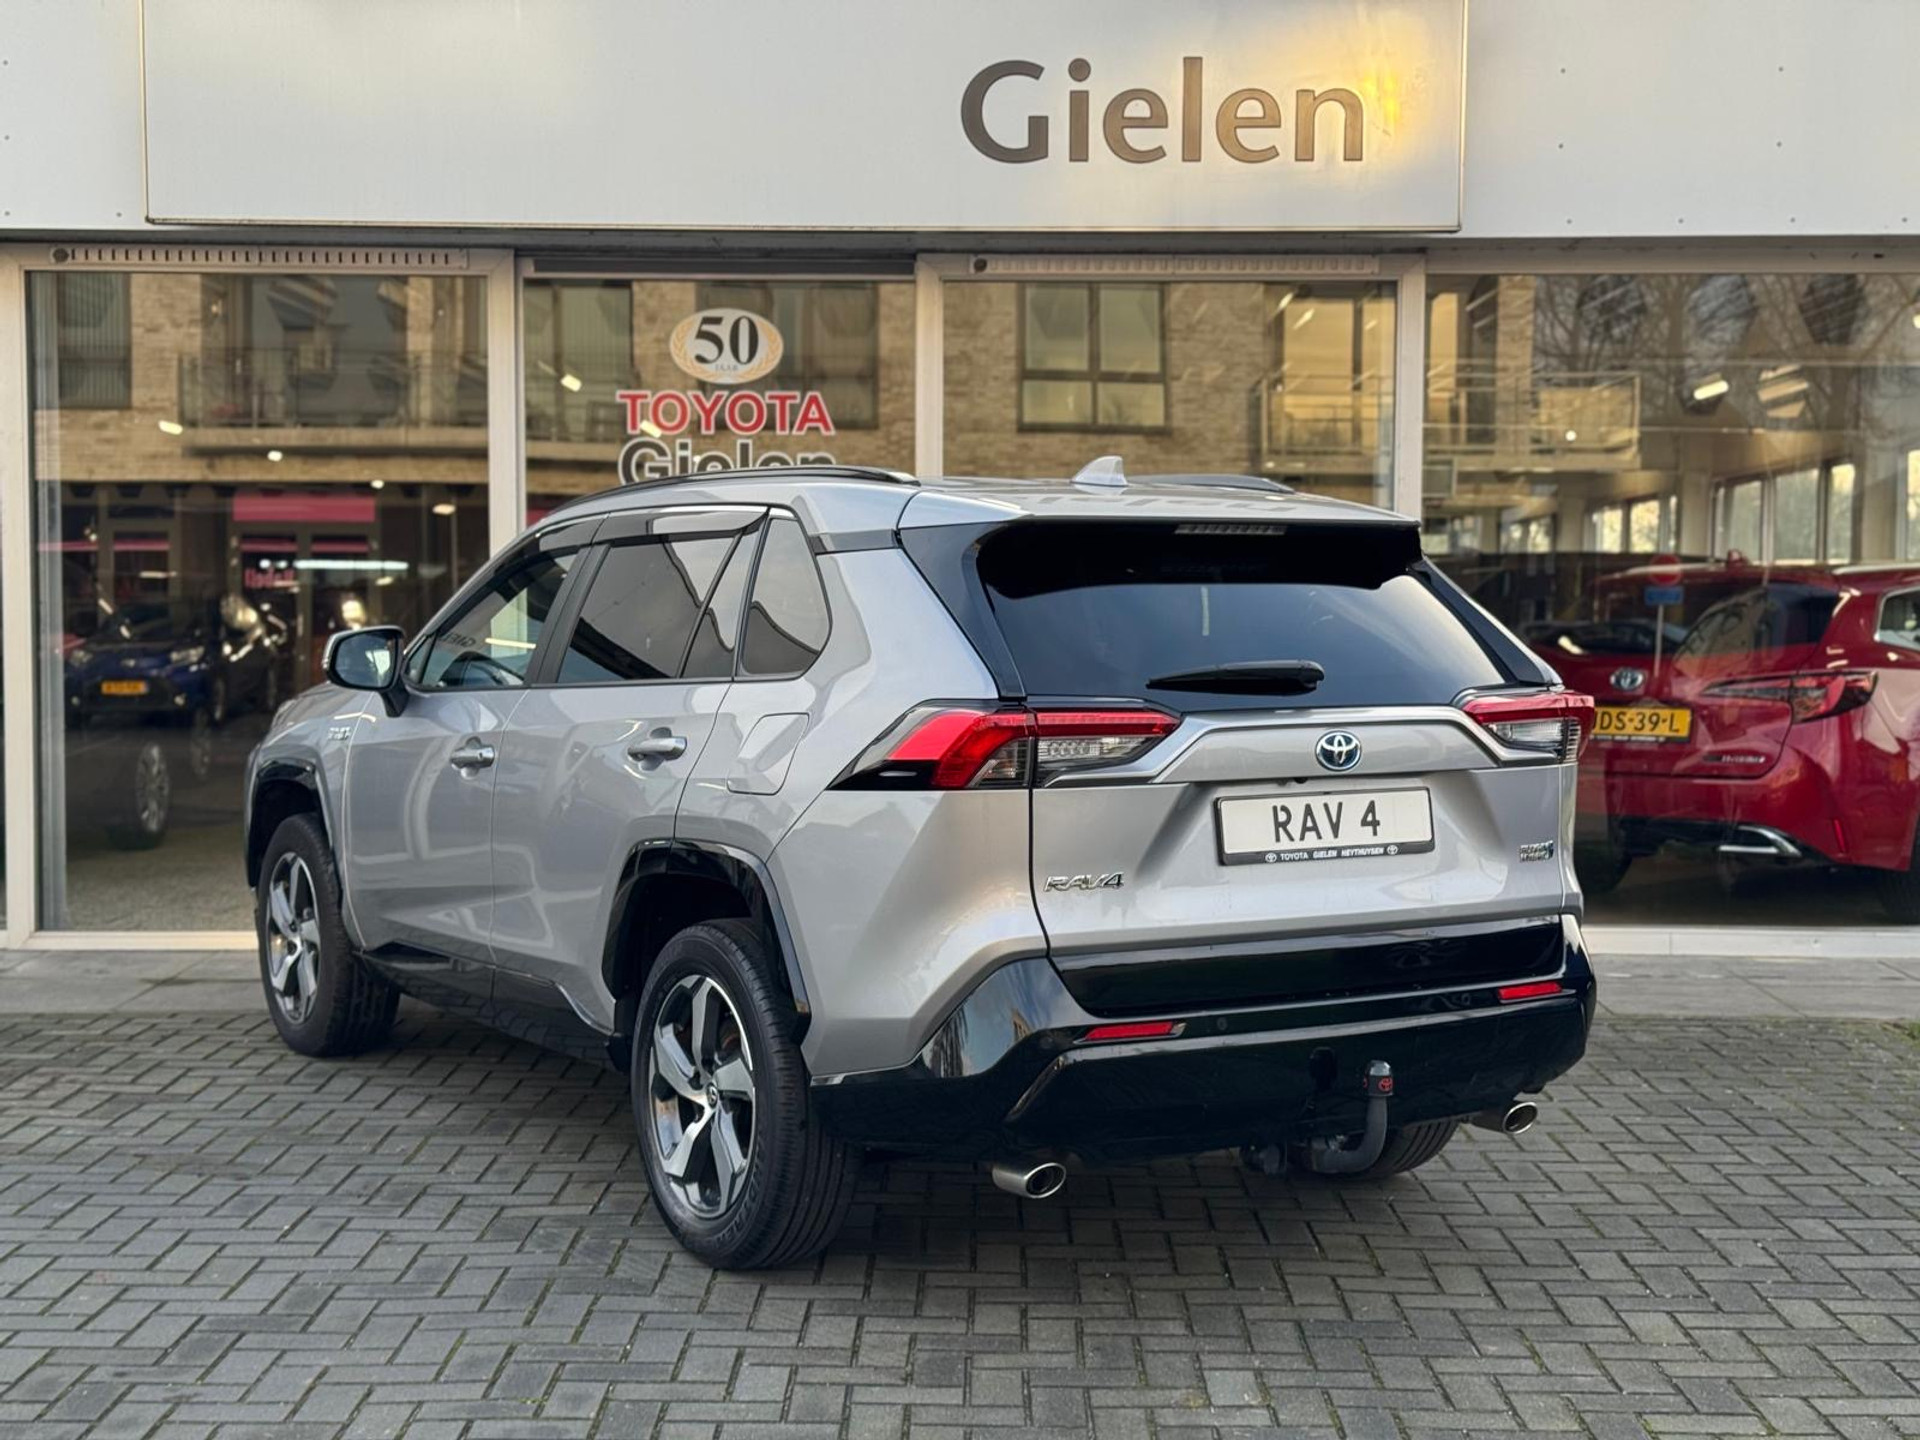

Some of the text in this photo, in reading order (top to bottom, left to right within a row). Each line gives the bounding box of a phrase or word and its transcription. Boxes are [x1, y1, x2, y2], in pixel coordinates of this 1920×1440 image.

[960, 56, 1364, 164] Gielen
[694, 315, 759, 365] 50
[616, 390, 836, 436] TOYOTA
[1593, 710, 1680, 733] DS-39-L
[1272, 799, 1381, 842] RAV 4
[1280, 851, 1309, 861] TOYOTA
[1043, 871, 1124, 893] RAV4
